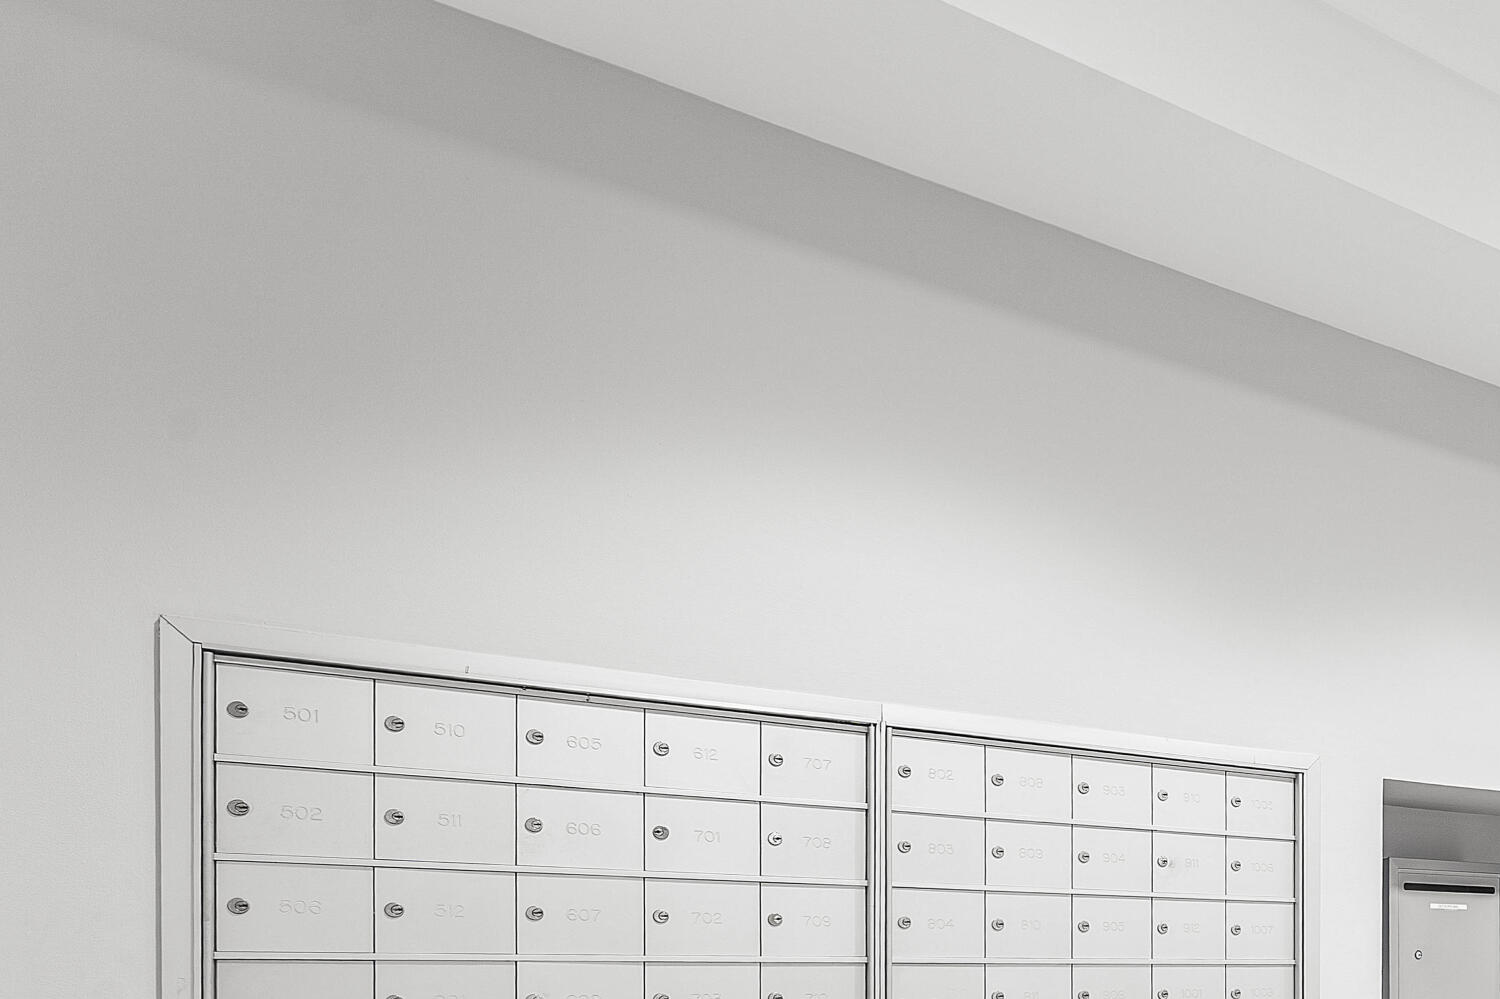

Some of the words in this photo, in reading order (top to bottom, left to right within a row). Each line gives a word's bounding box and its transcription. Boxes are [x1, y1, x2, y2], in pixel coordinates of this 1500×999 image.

[282, 707, 320, 723] 501
[433, 722, 465, 738] 510
[566, 736, 602, 750] 605
[694, 748, 719, 761] 612
[803, 757, 832, 770] 707
[928, 768, 954, 780] 802
[280, 806, 322, 821] 502
[437, 813, 462, 828] 511
[566, 822, 602, 836] 606
[694, 830, 720, 844] 701
[801, 836, 832, 849] 708
[433, 904, 464, 918] 512
[566, 909, 602, 922] 607
[690, 912, 723, 924] 702
